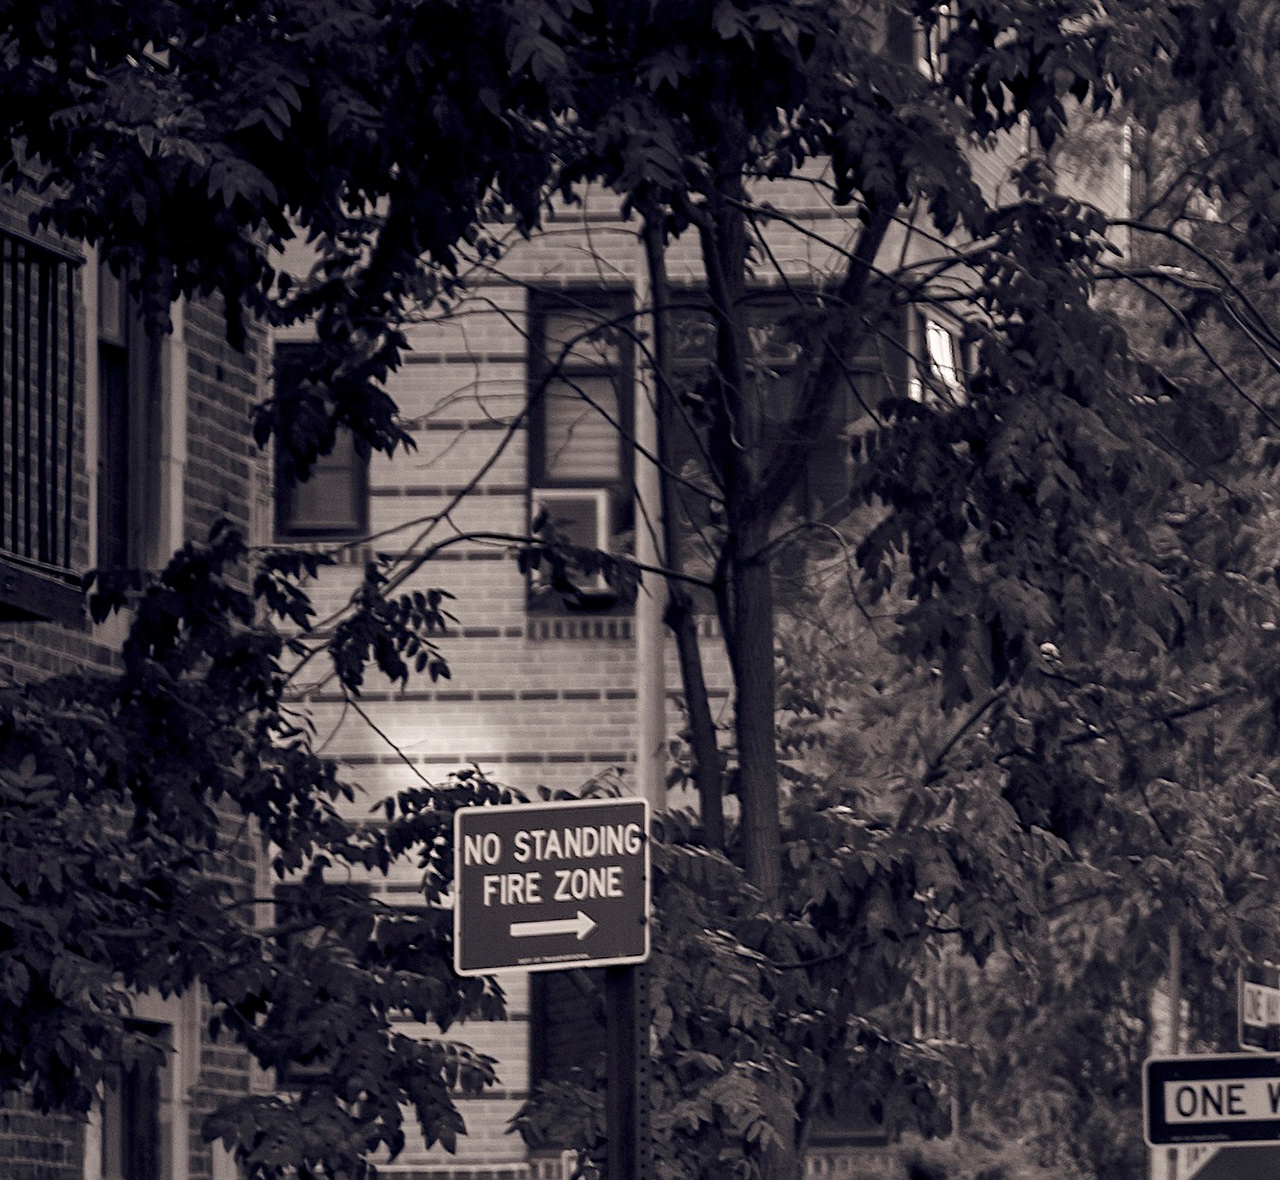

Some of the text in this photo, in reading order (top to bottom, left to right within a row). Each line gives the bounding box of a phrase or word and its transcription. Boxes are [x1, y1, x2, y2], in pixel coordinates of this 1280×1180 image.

[464, 824, 642, 865] NO STANDING
[484, 866, 624, 906] FIRE ZONE
[1175, 1084, 1246, 1117] ONE
